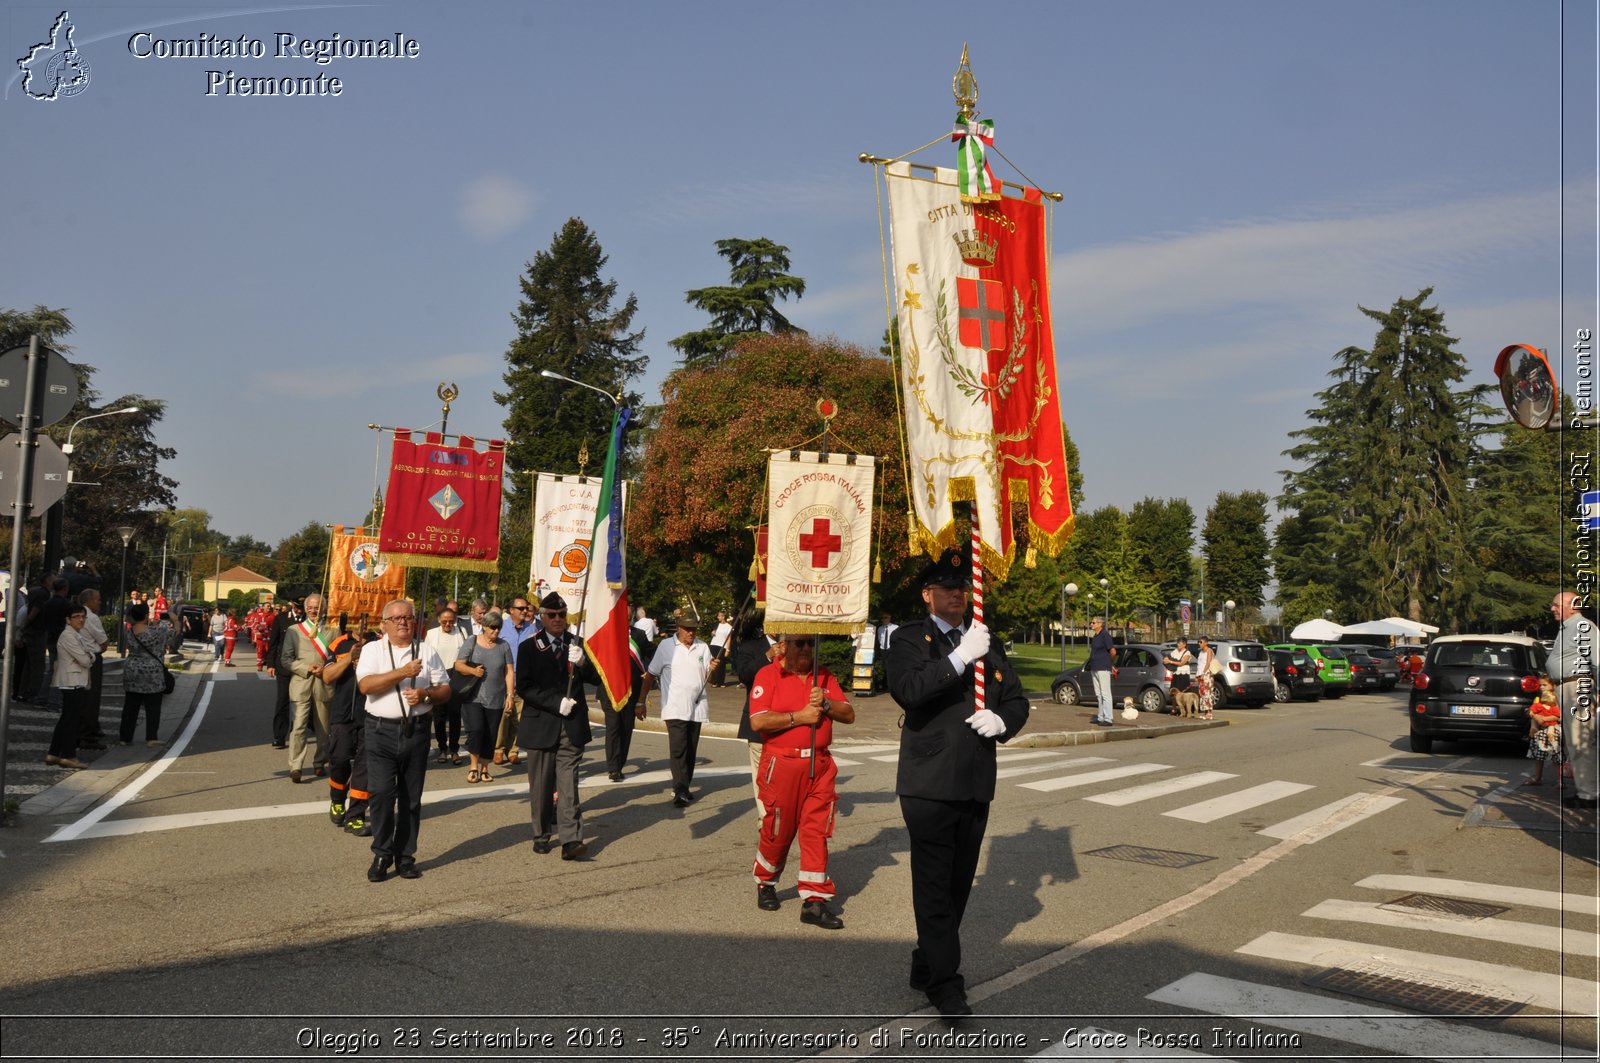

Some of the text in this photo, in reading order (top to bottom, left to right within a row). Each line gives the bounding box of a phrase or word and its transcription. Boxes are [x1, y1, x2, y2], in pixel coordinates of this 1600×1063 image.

[976, 205, 1016, 233] OLEGGIO
[775, 472, 866, 515] CROCE ROSSA ITALIANA
[425, 525, 461, 535] COMUNALE
[407, 532, 476, 545] OLEGGIO
[787, 583, 850, 594] COMITATO DI
[794, 604, 844, 614] ARONA
